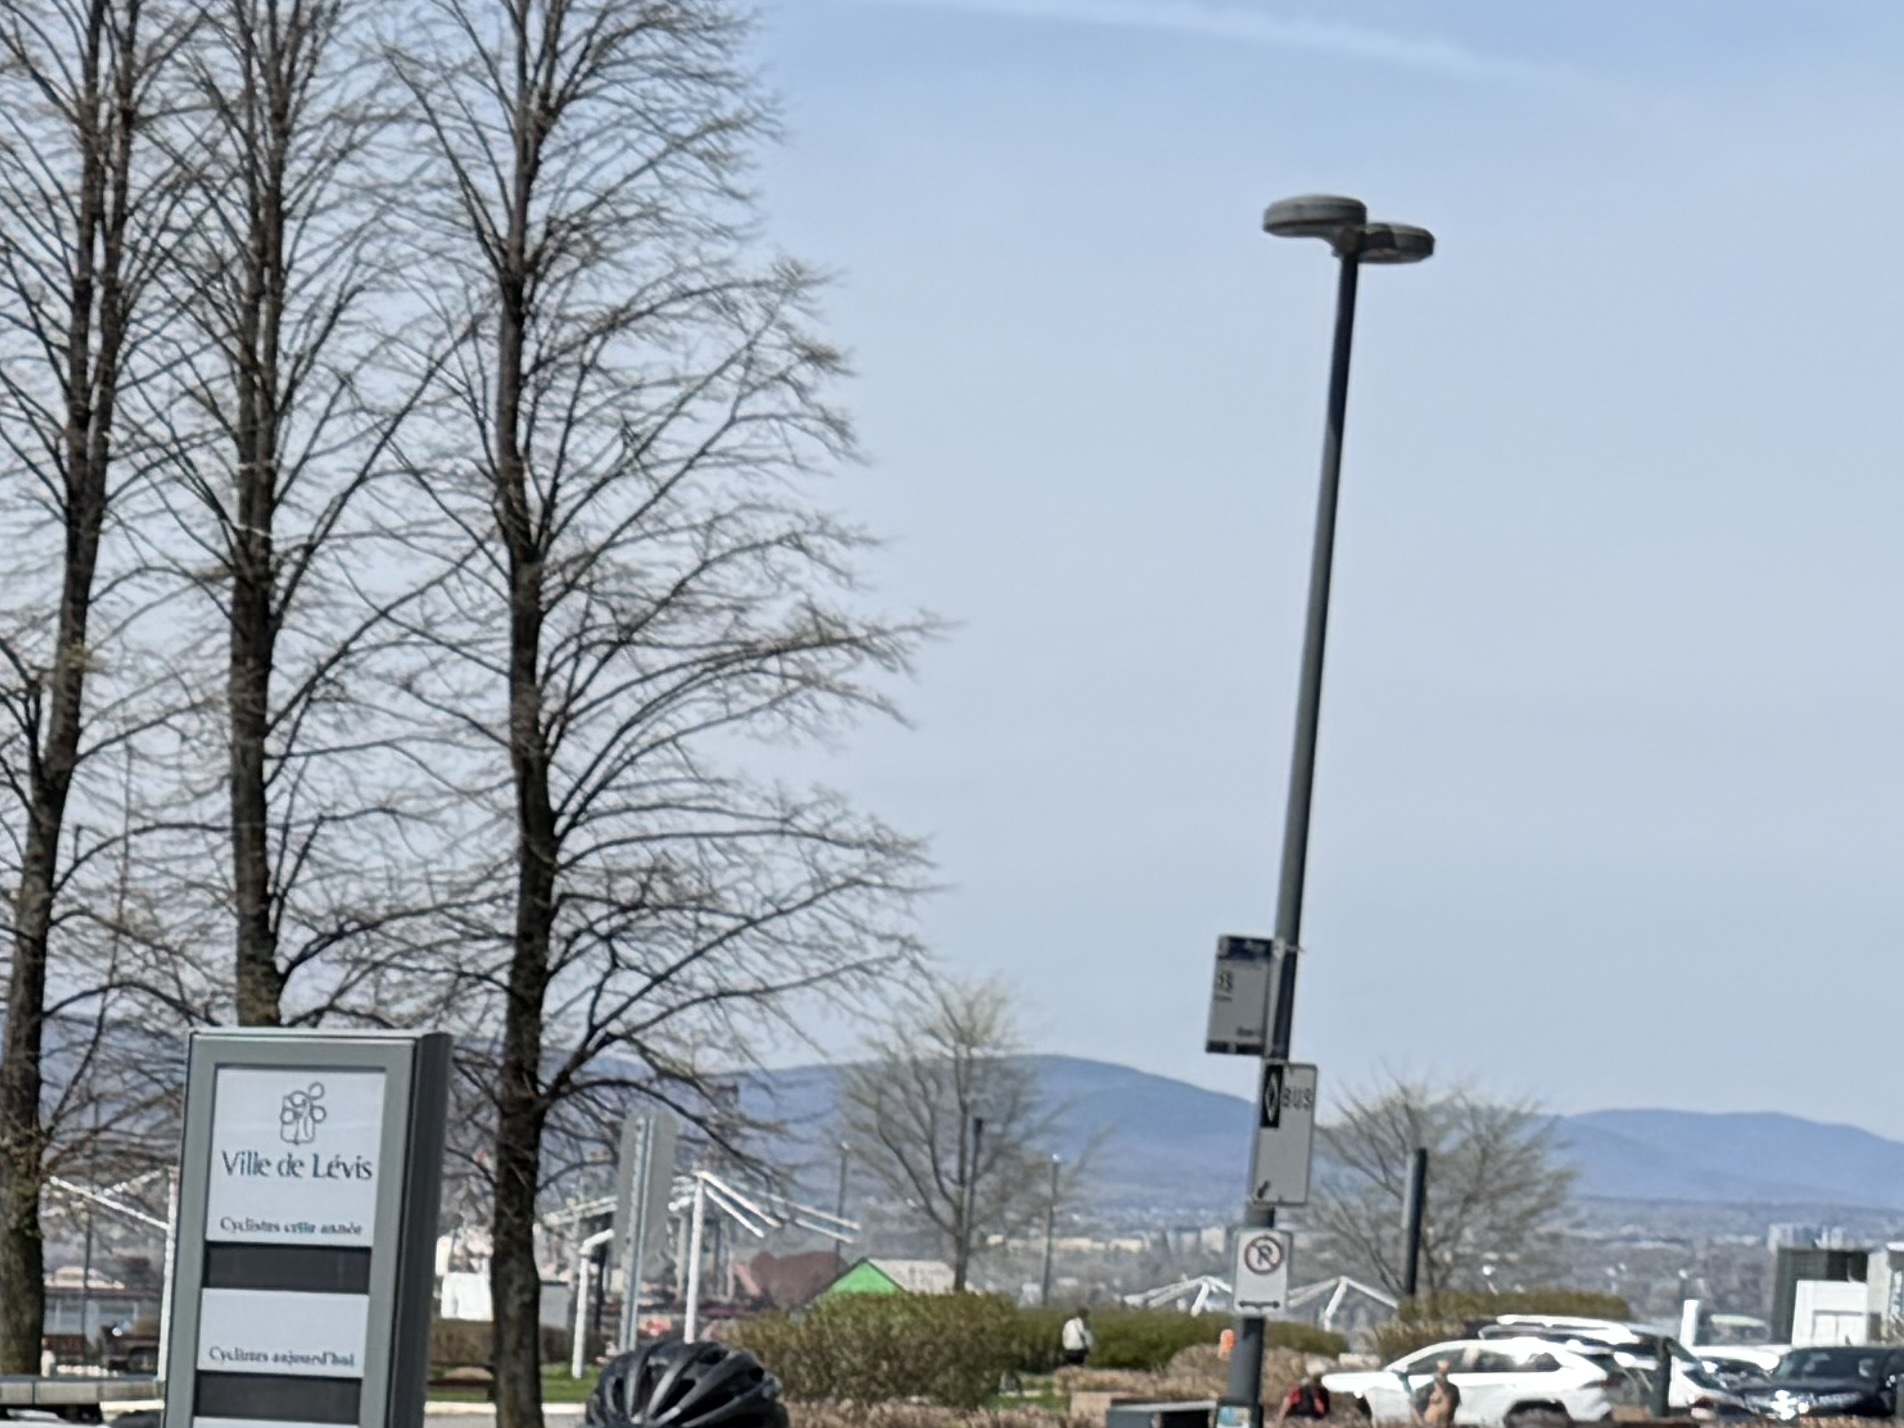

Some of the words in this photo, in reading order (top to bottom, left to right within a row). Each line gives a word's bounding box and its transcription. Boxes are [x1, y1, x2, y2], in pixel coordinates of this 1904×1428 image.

[1282, 1085, 1313, 1111] BUS
[222, 1150, 272, 1177] Ville
[277, 1152, 306, 1179] de
[311, 1153, 373, 1181] Lévis
